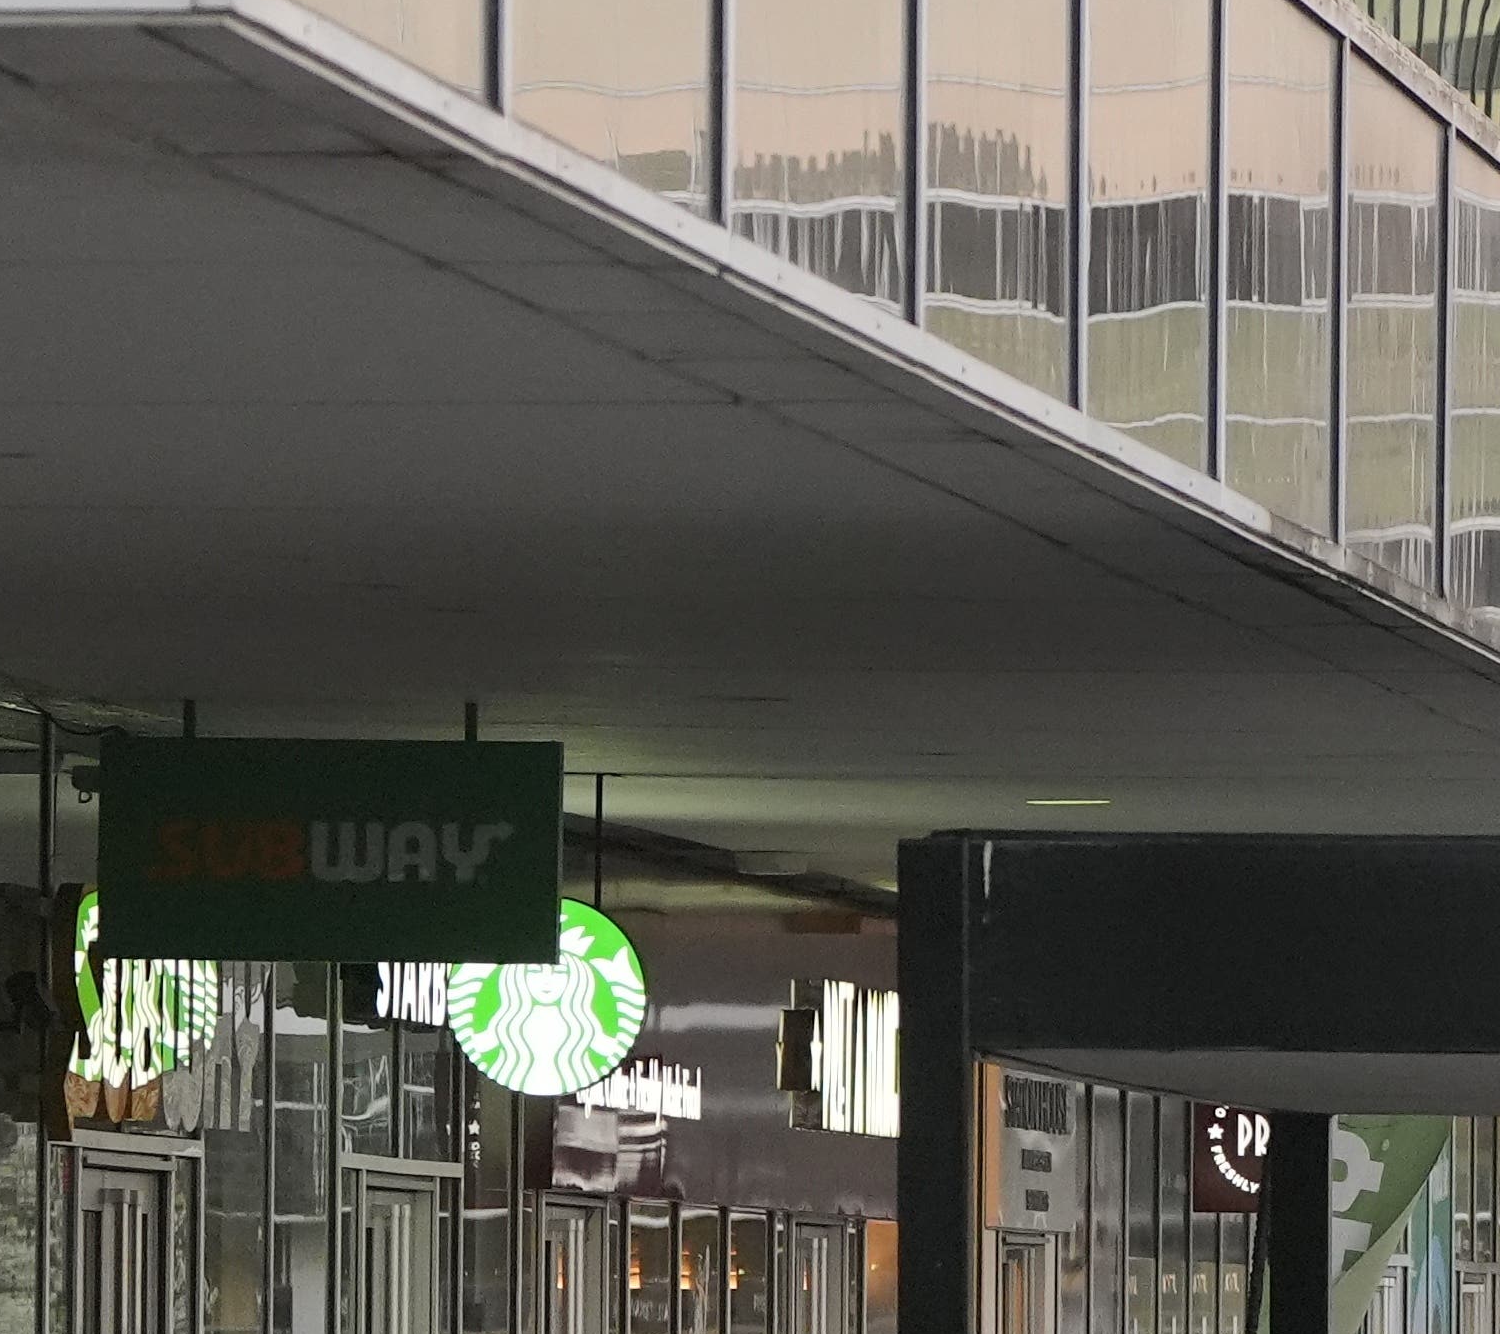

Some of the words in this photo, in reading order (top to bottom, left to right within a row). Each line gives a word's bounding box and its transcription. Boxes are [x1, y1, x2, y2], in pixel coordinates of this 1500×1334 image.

[146, 819, 515, 884] SUBWAY
[376, 962, 449, 1027] STARB
[1237, 1113, 1272, 1157] PR
[1210, 1145, 1261, 1194] FRESHLY
